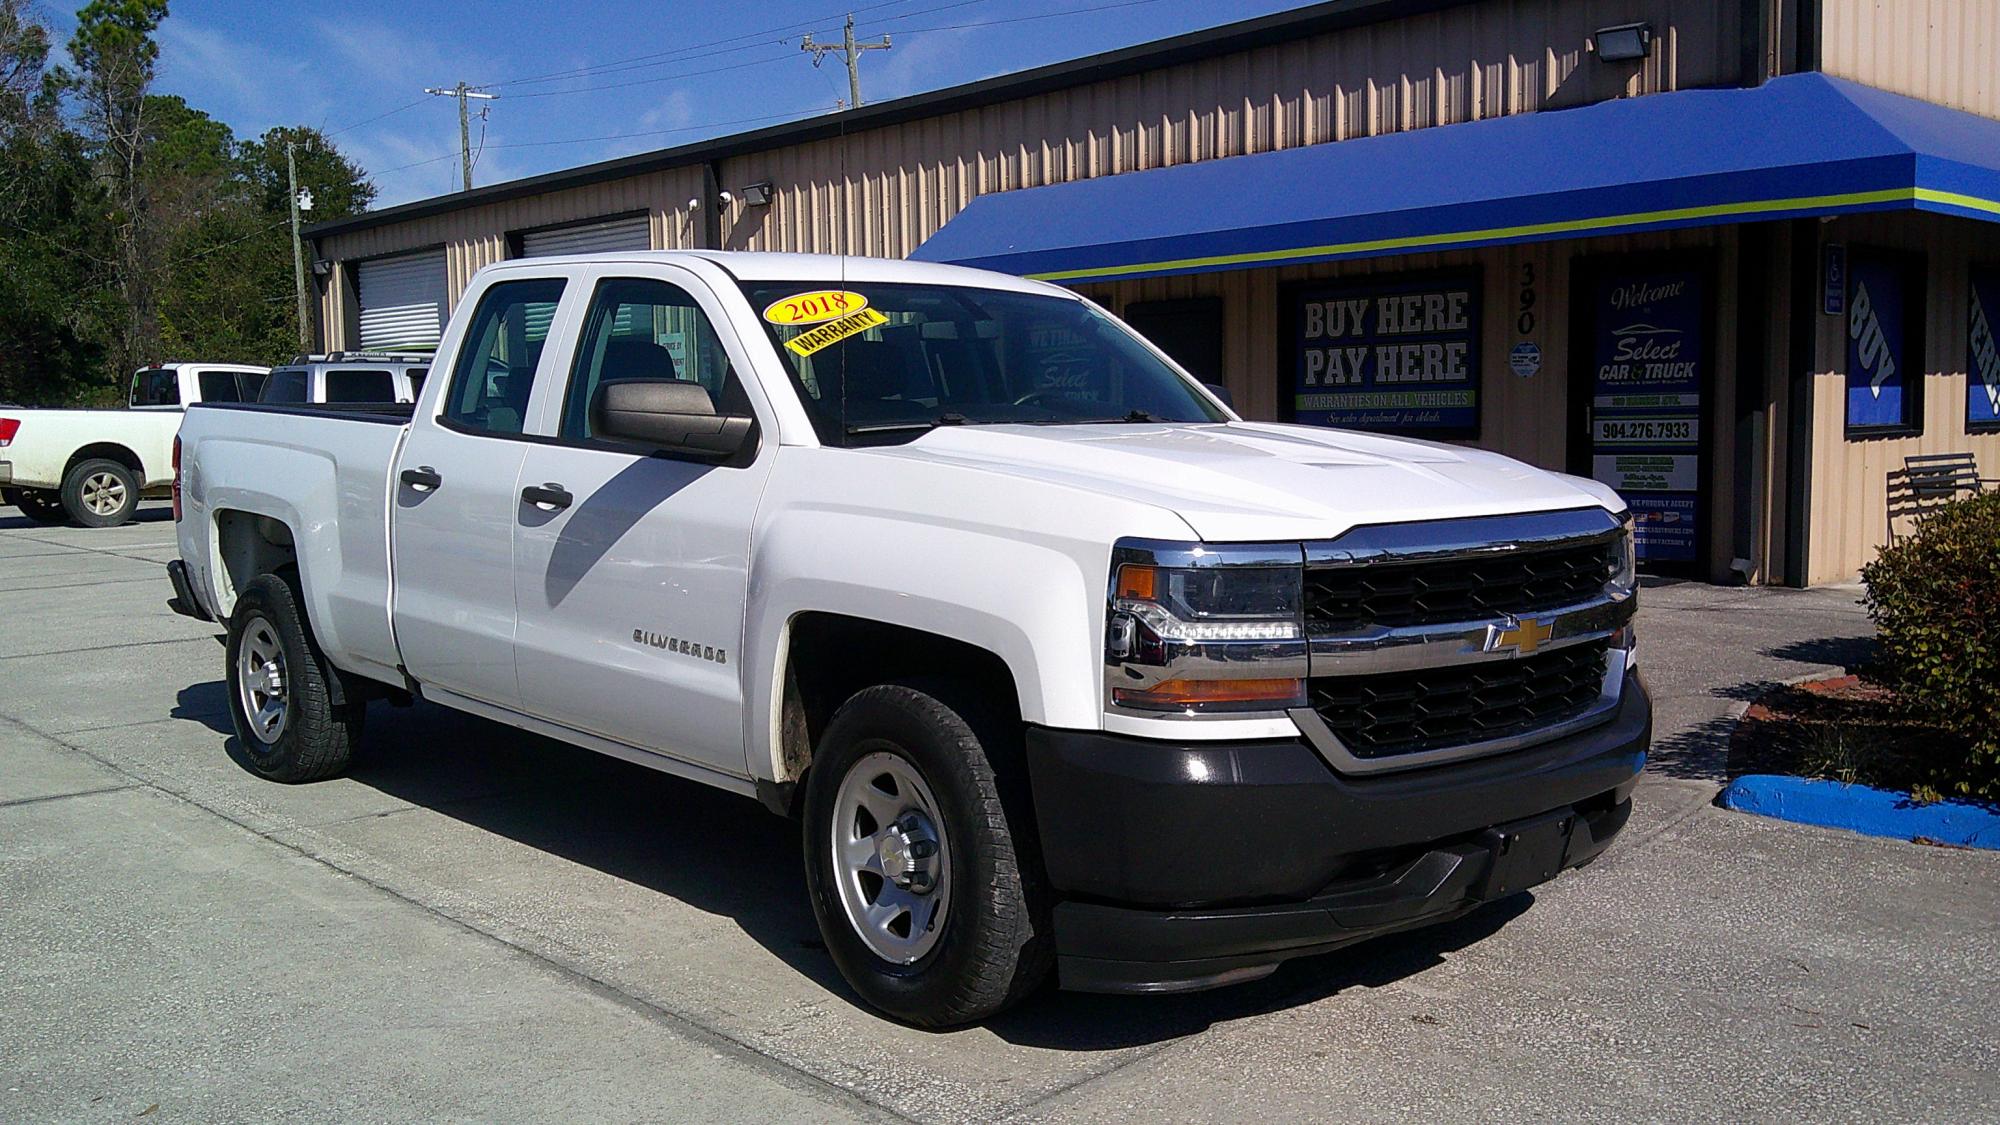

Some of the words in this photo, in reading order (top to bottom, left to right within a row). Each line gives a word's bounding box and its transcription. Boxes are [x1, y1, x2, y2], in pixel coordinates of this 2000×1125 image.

[785, 291, 849, 321] 2018
[1611, 281, 1685, 310] Welcome
[1305, 300, 1369, 338] BUY
[1376, 292, 1468, 334] HERE
[794, 311, 876, 352] WARRANTY
[1850, 280, 1896, 400] BUY
[1305, 348, 1368, 385] PAY
[1375, 342, 1467, 382] HERE
[1613, 337, 1681, 361] Select
[1599, 365, 1630, 380] CAR
[1645, 362, 1696, 379] TRUCK
[1303, 395, 1371, 408] WARRANTIES
[1373, 394, 1388, 407] ON
[1390, 393, 1411, 406] ALL
[1414, 391, 1469, 406] VEHICLES
[1603, 422, 1690, 439] 904.276.7933
[632, 628, 727, 664] SILVERADO
